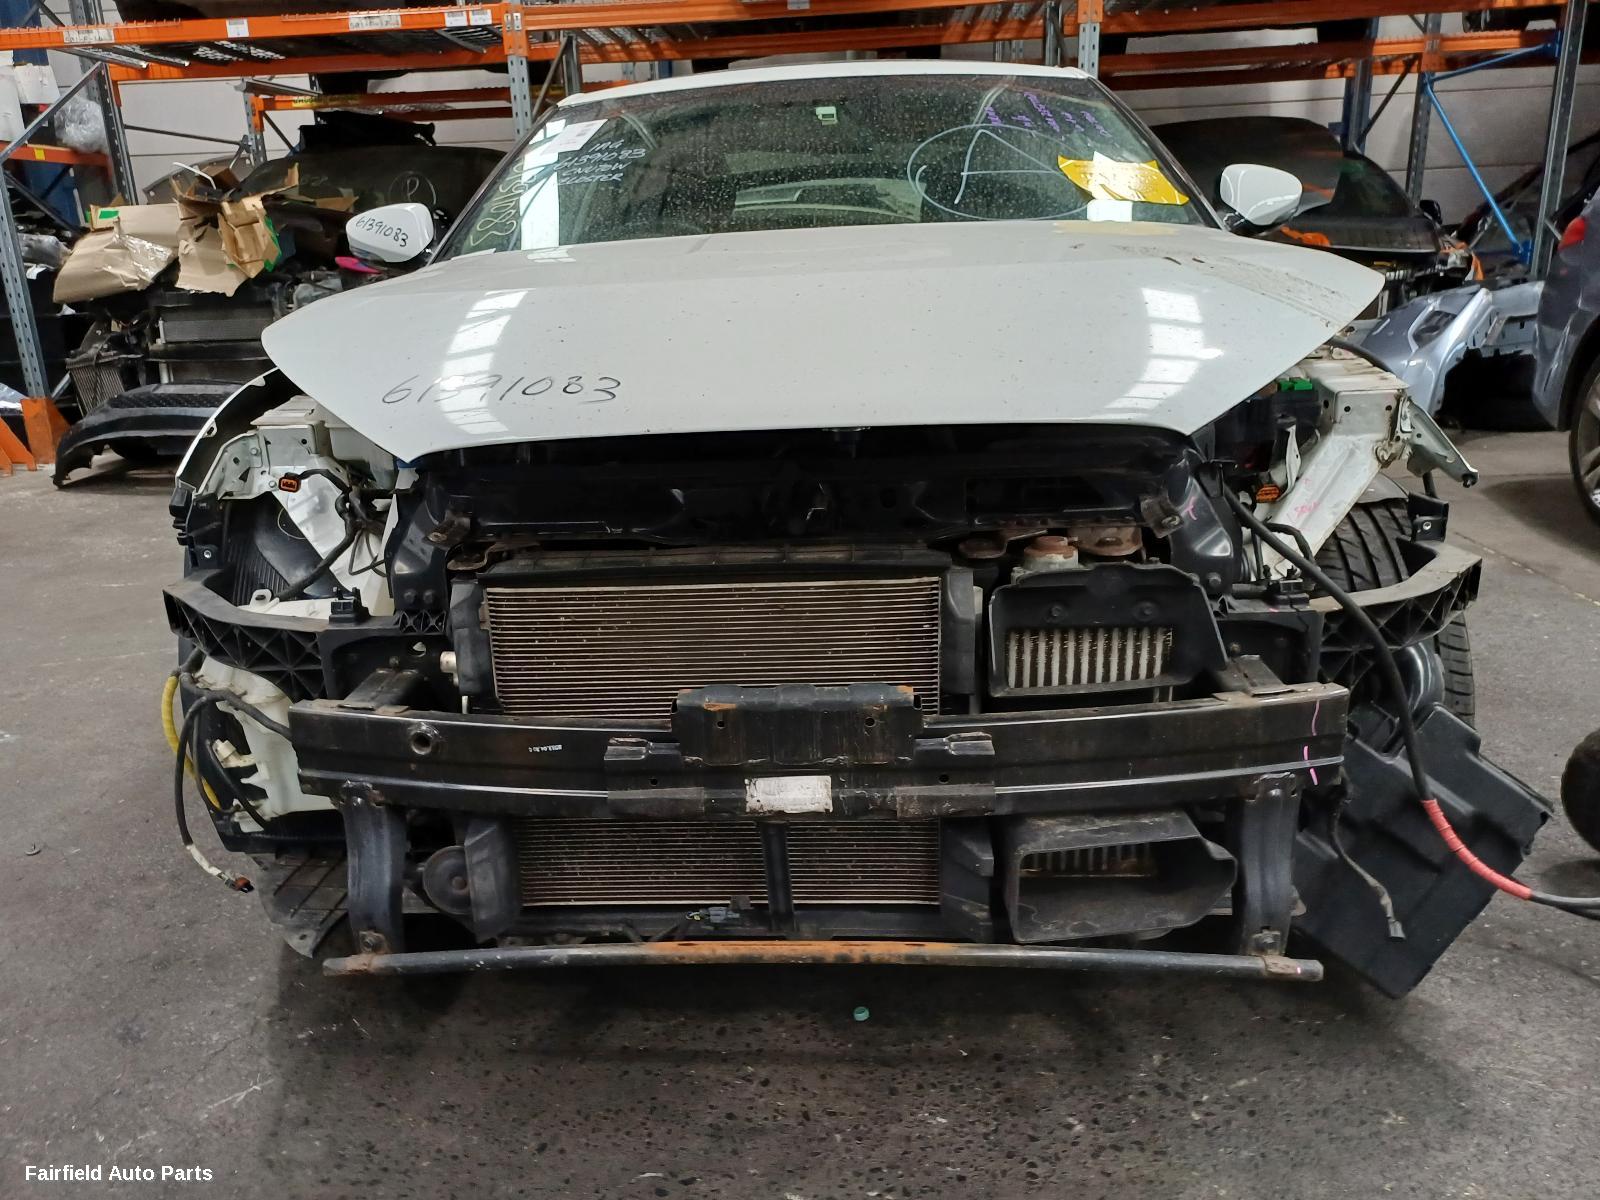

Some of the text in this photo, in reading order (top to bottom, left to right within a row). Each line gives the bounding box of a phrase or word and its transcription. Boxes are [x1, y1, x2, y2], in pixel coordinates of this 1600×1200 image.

[553, 148, 646, 170] 61391083
[355, 216, 409, 248] 61391083
[382, 375, 621, 404] 61391083
